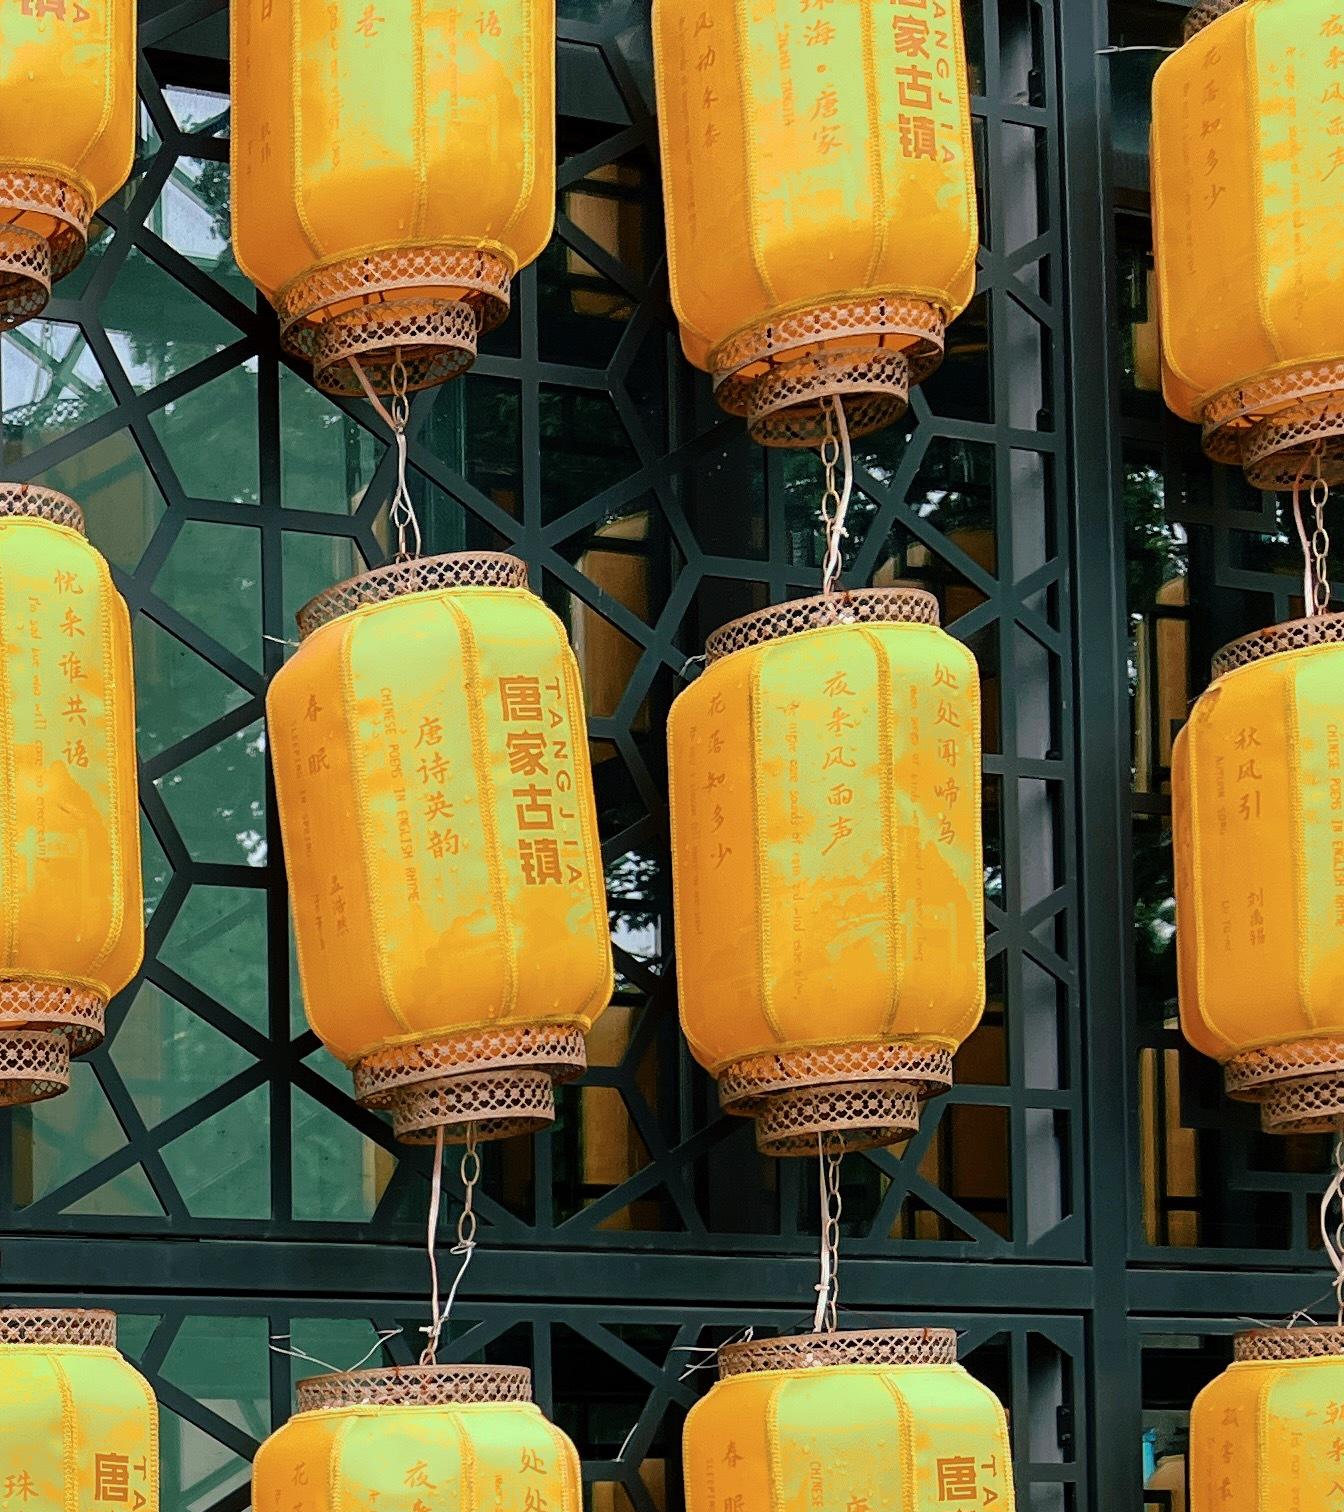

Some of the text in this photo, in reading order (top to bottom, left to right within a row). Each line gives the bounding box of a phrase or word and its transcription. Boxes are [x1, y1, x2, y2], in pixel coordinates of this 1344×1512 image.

[54, 569, 91, 769] 忧来谁共语
[933, 663, 960, 845] 处处闻啼鸟
[380, 687, 419, 901] CHINESE POEMS IN ENGLISH RHYME
[415, 716, 460, 860] 唐诗英韵
[499, 674, 562, 886] 唐家古镇
[545, 678, 581, 887] TANGJIA
[822, 670, 856, 856] 夜来风雨声
[1234, 727, 1262, 822] 秋风引
[810, 1461, 824, 1507] CHINESE
